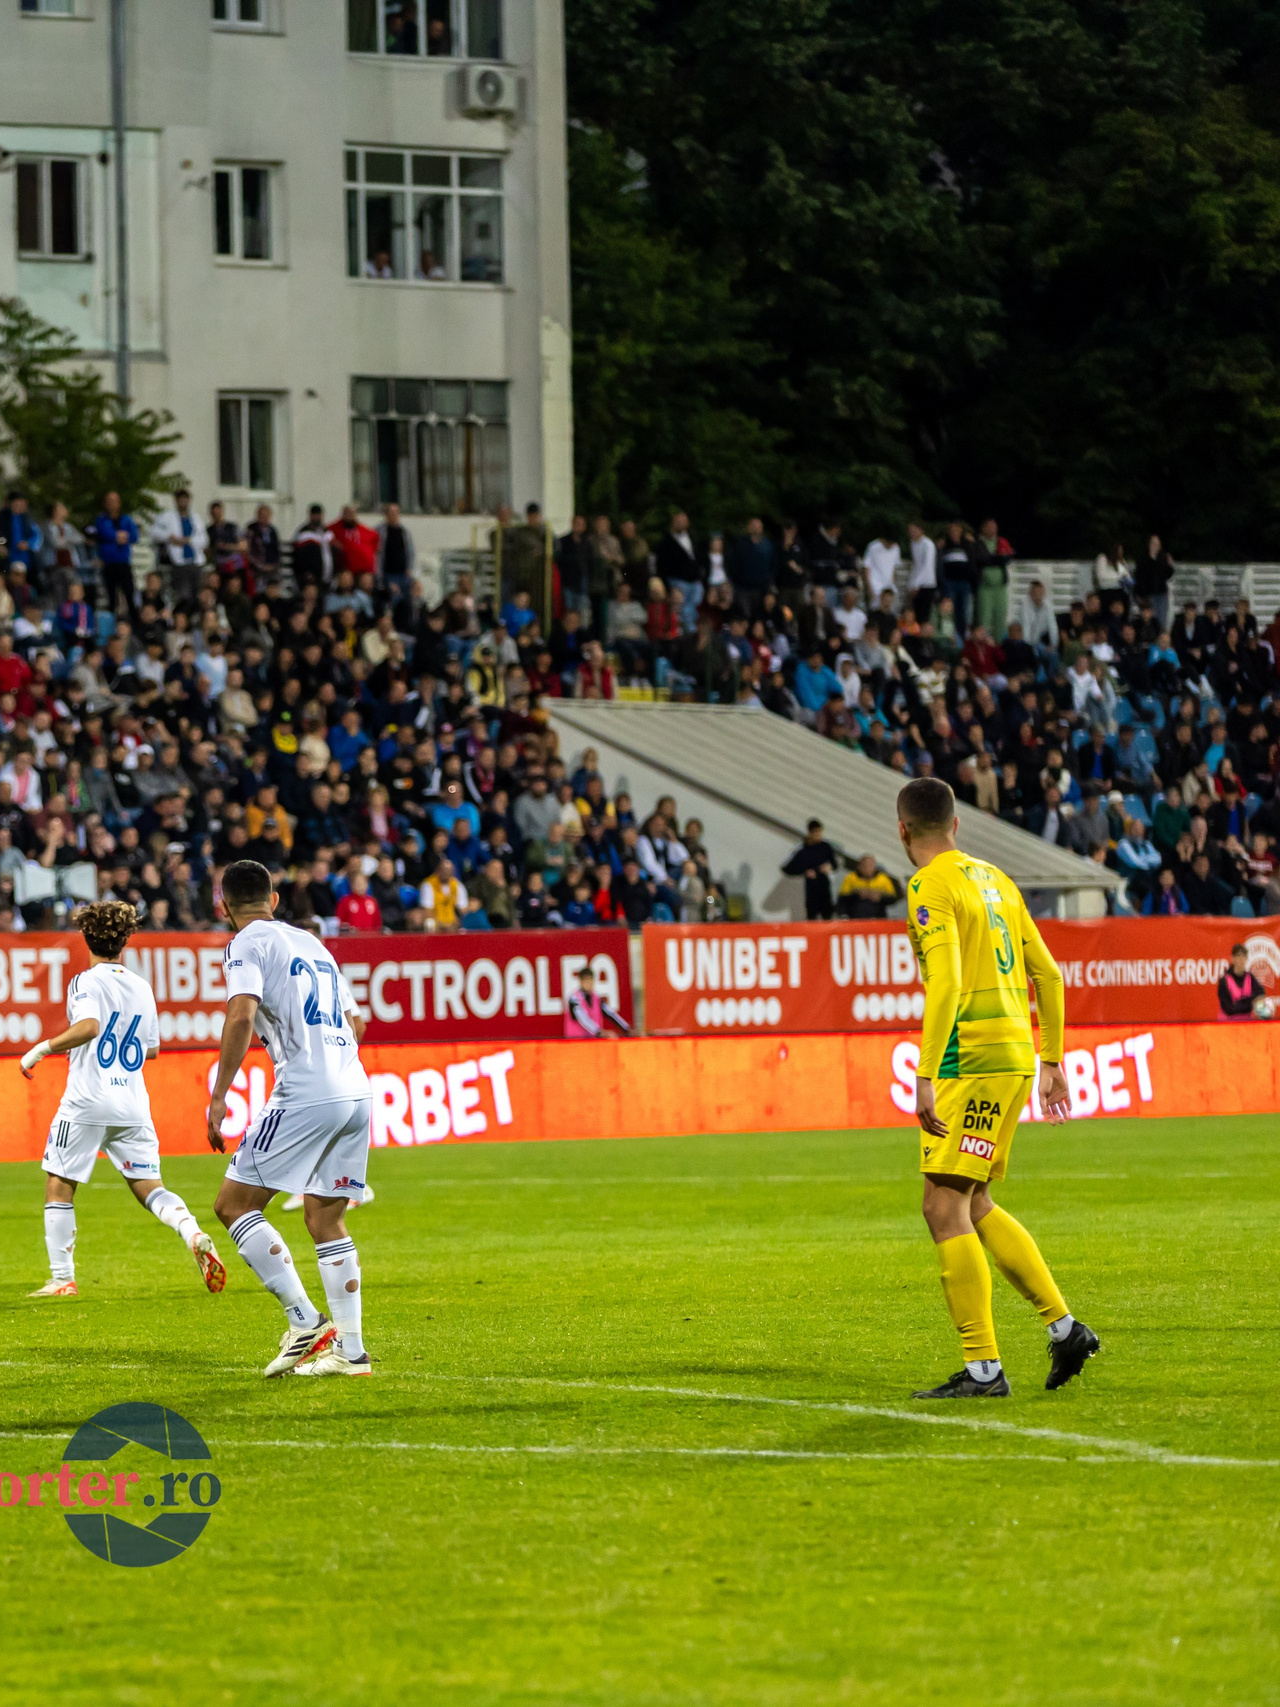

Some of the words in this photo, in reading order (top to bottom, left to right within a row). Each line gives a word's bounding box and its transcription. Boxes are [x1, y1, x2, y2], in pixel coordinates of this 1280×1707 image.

[982, 889, 1015, 975] 5
[124, 947, 224, 1003] NIBE
[342, 953, 619, 1023] ECTROALFA
[666, 936, 807, 992] UNIBET
[830, 934, 924, 987] UNIB
[1057, 961, 1084, 988] IVE
[1086, 959, 1172, 987] CONTINENTS
[290, 956, 342, 1028] 27
[97, 1011, 143, 1072] 66
[207, 1050, 516, 1146] SRBET
[963, 1114, 993, 1131] DIN
[964, 1099, 1001, 1116] APA
[960, 1136, 995, 1159] NOY
